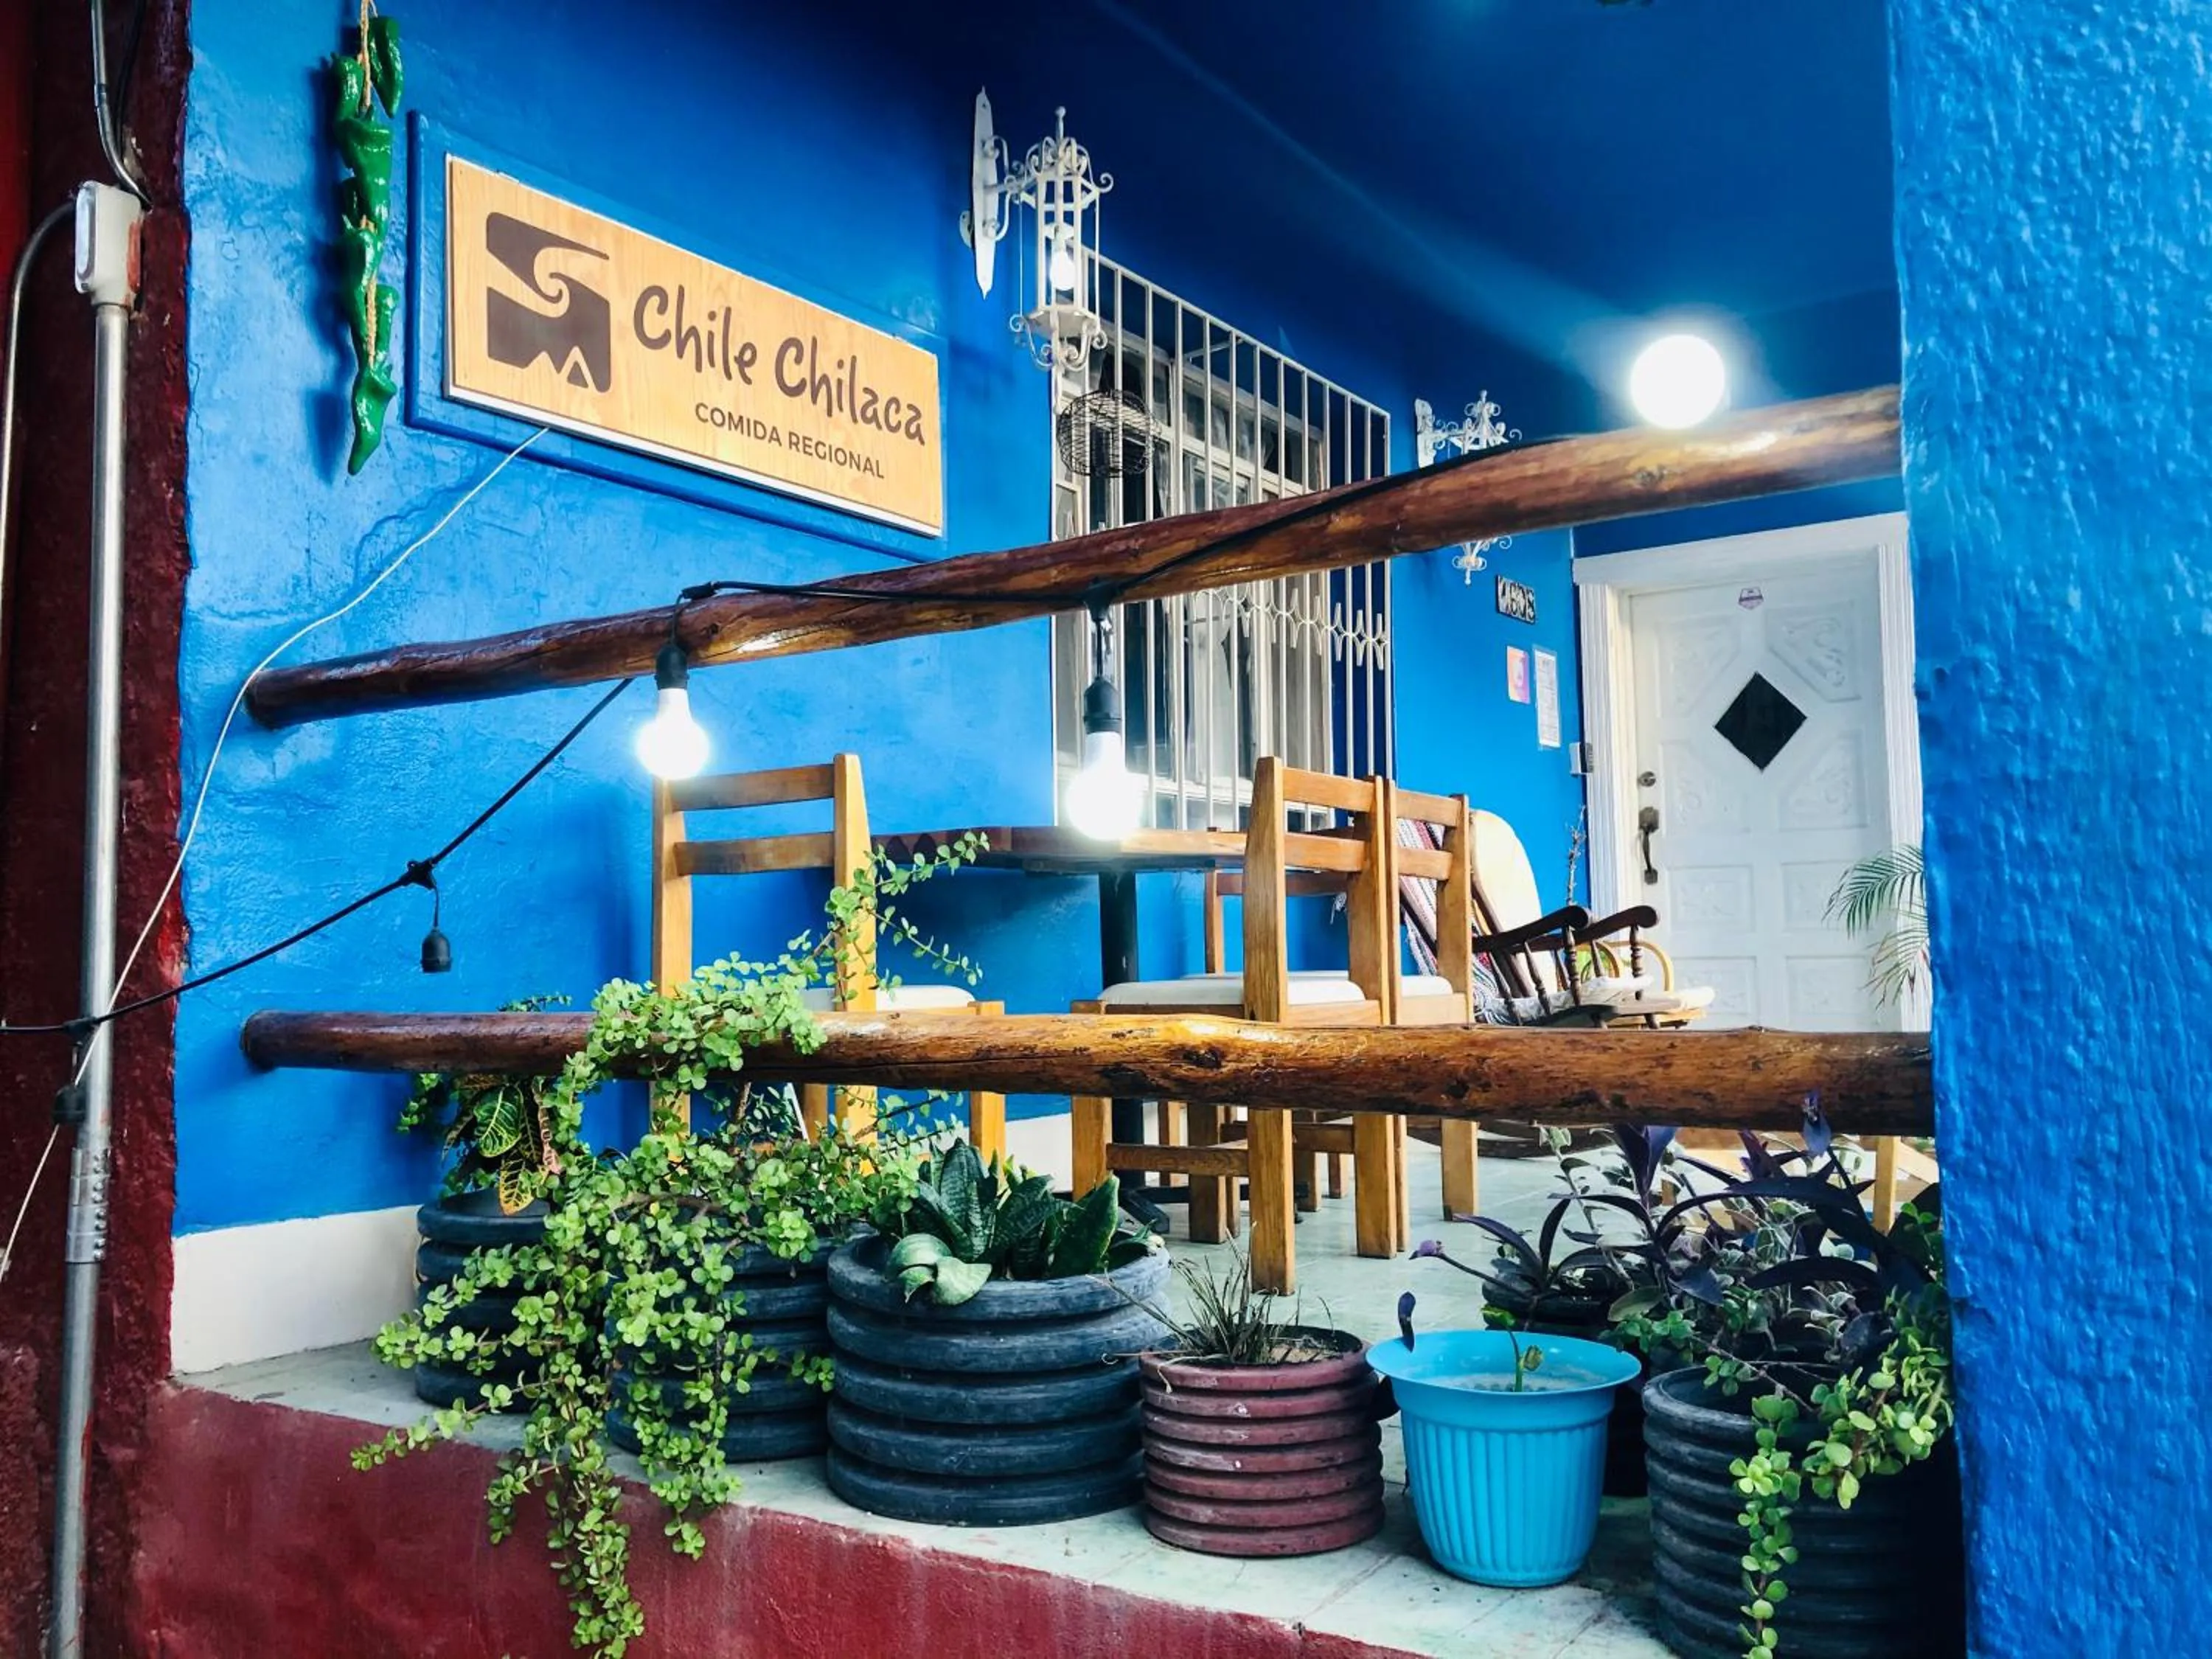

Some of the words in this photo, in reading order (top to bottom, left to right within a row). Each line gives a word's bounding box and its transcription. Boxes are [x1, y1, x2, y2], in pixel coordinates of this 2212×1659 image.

[633, 285, 758, 386] Chile
[775, 336, 926, 447] Chilaca
[695, 402, 783, 447] COMIDA
[788, 431, 886, 479] REGIONAL
